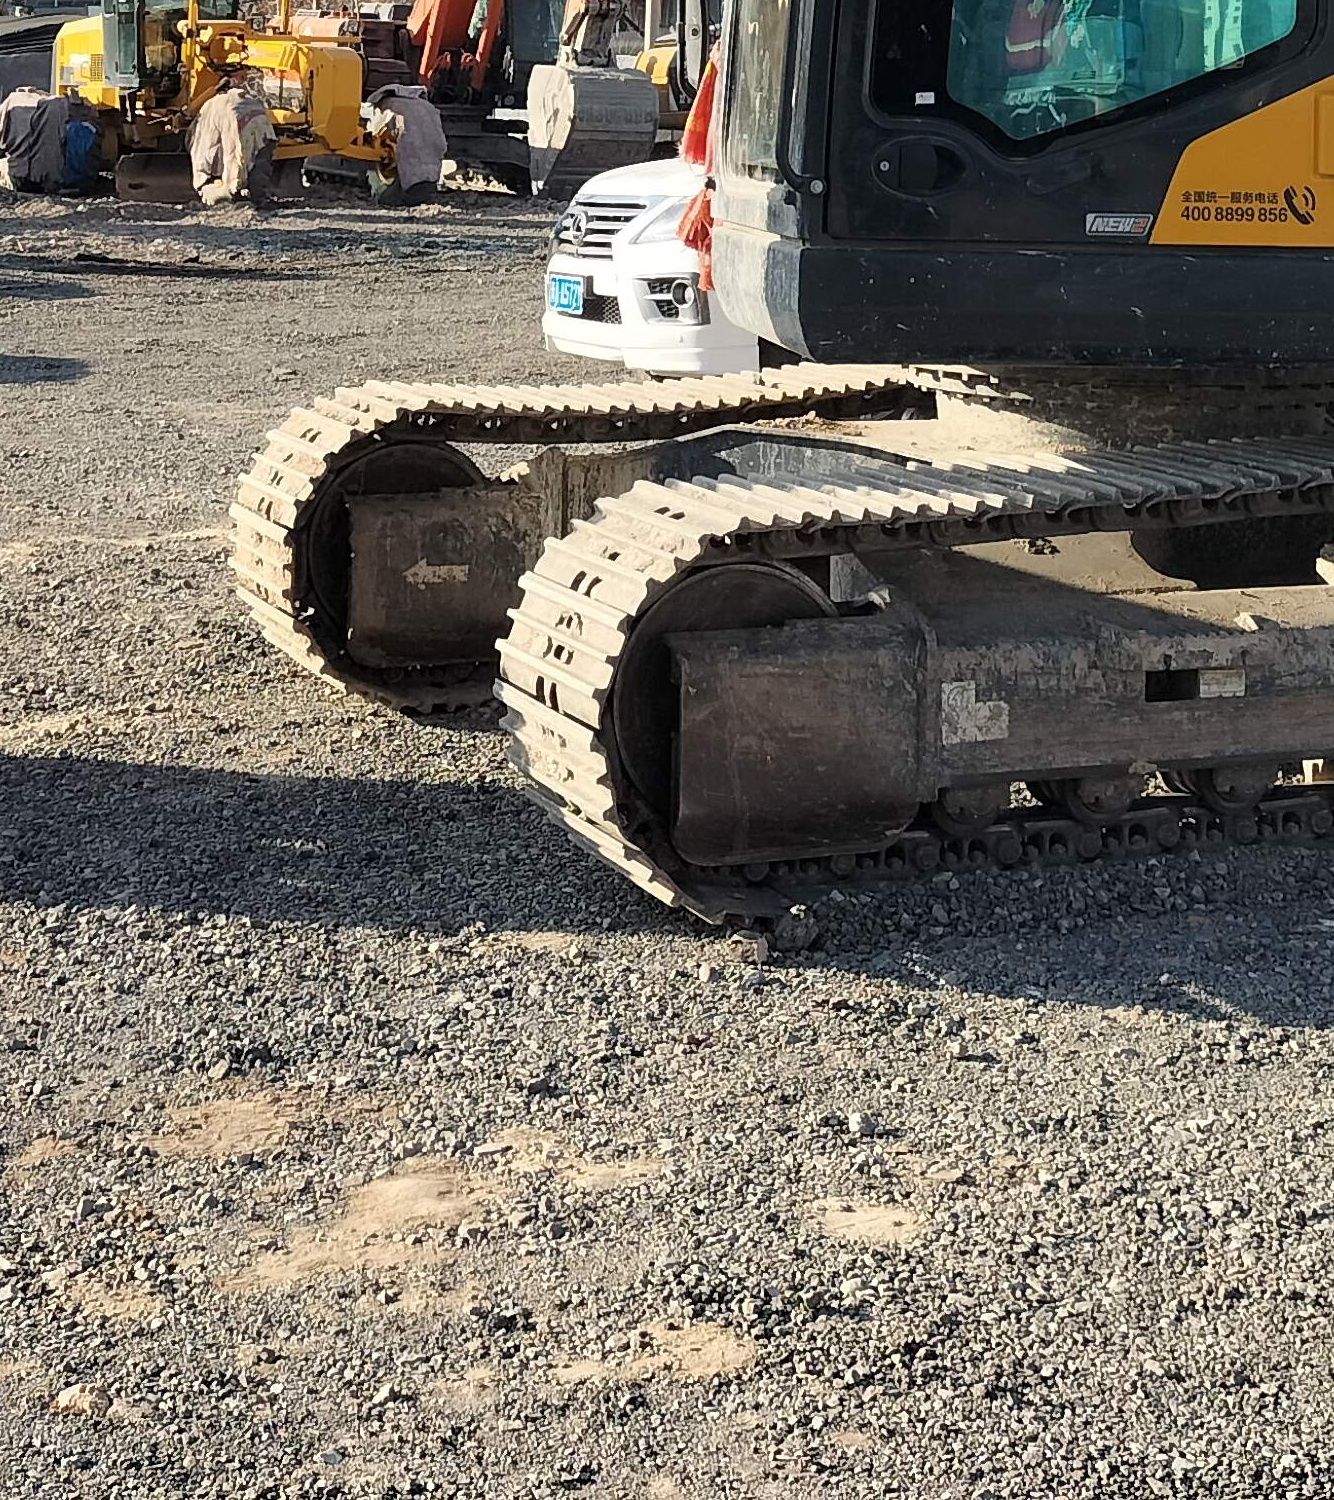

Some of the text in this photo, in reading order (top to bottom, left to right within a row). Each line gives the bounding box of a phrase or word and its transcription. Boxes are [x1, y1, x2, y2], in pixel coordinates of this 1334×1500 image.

[1181, 191, 1279, 204] 全国统一服务电话
[1181, 206, 1288, 223] 400 8899 856
